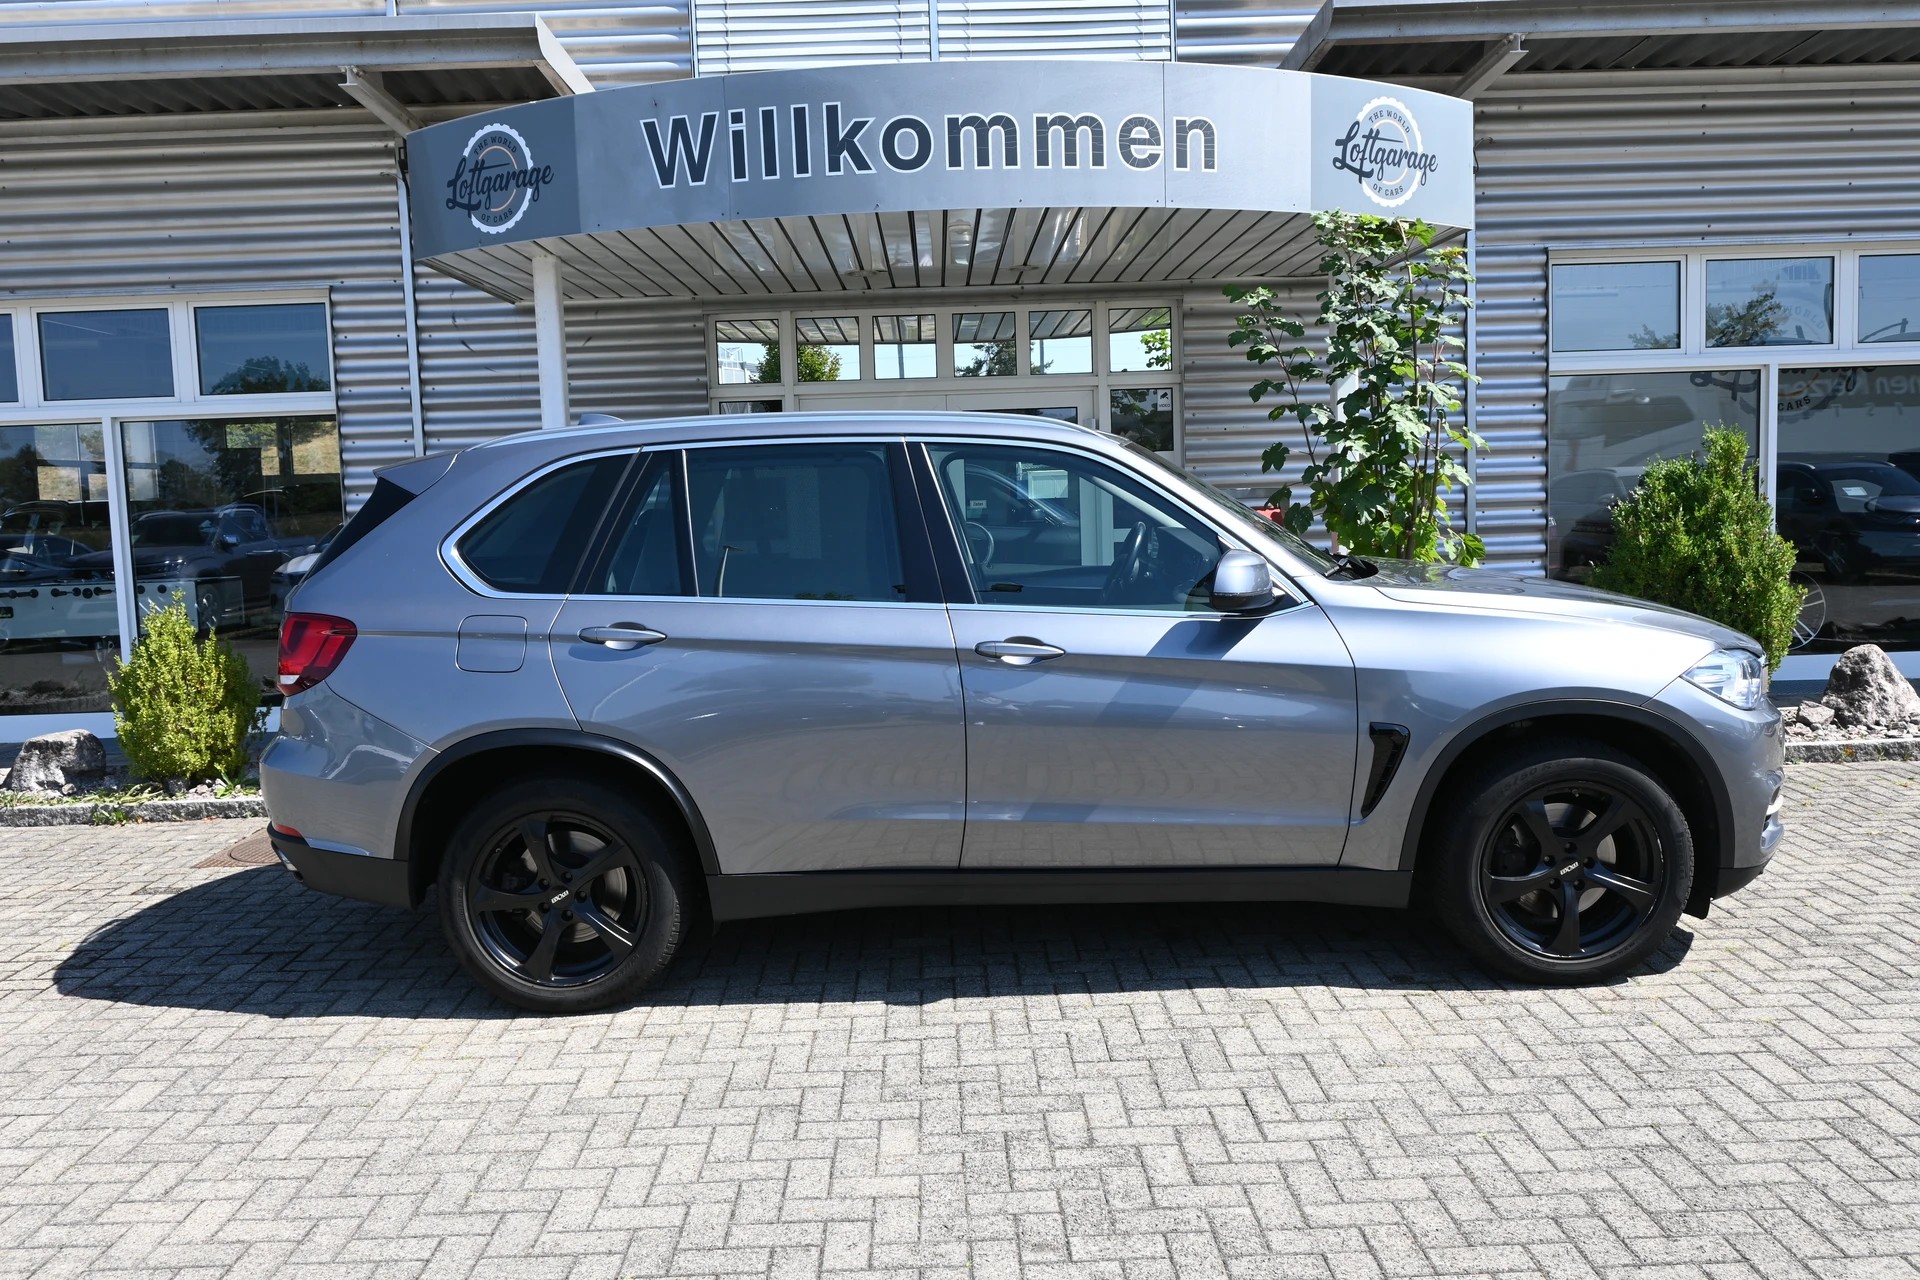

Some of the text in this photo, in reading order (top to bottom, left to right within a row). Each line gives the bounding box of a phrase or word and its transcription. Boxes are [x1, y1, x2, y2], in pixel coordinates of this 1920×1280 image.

[1368, 109, 1411, 134] THE WORLD
[474, 136, 517, 156] THE WORLD
[639, 101, 1218, 189] Willkommen
[1332, 120, 1439, 187] Loftgarage
[446, 157, 554, 219] Loftgarage
[1372, 183, 1404, 197] OF CARS
[481, 207, 513, 223] OF CARS
